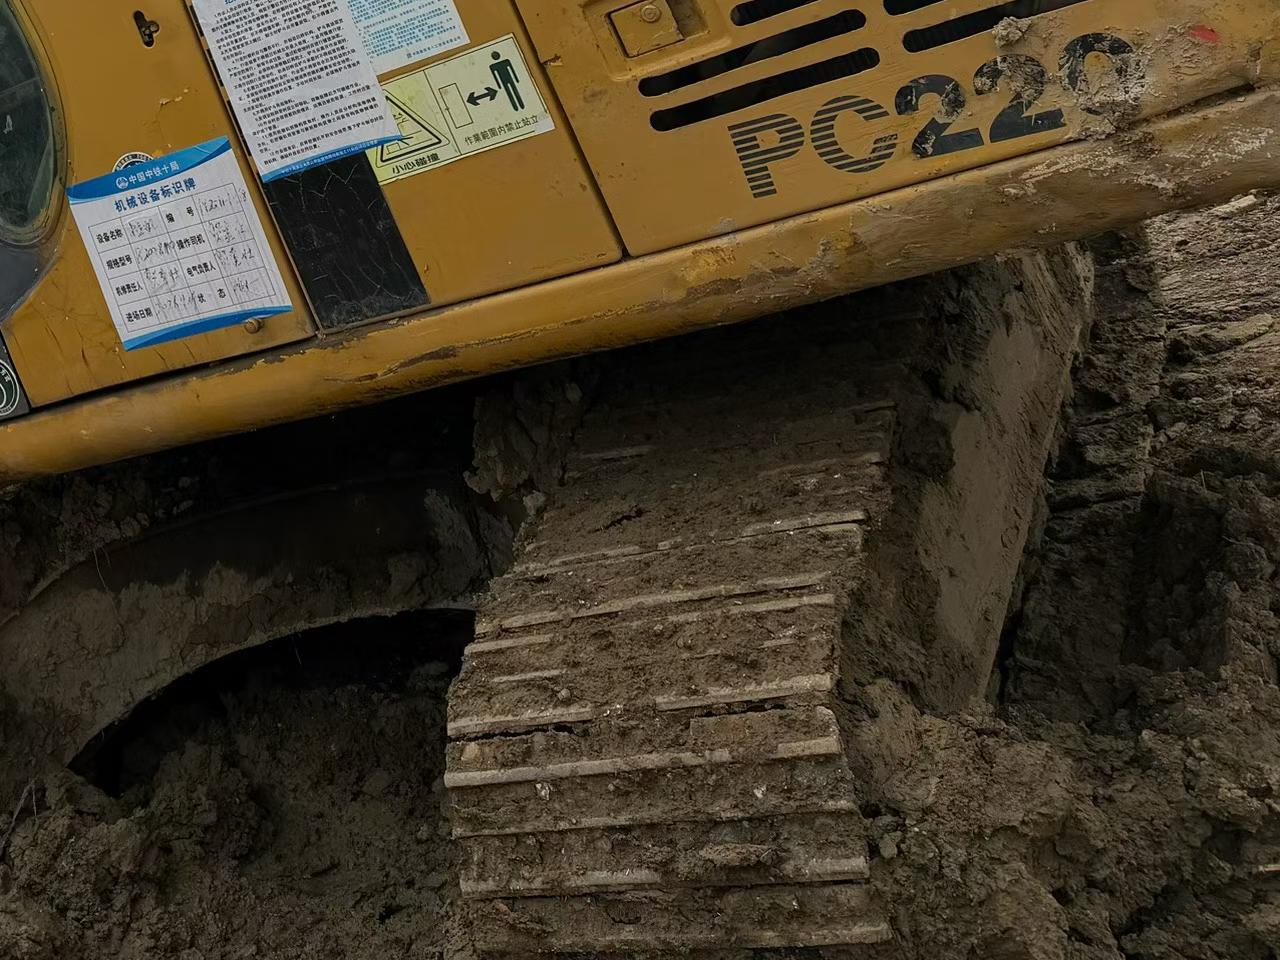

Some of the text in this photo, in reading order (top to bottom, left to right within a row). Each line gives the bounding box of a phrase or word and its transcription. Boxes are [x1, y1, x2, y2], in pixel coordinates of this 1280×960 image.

[127, 159, 180, 185] 中国中铁十局
[391, 151, 440, 175] 小心碰撞
[113, 176, 197, 212] 机械设备标识牌
[95, 227, 123, 244] 设备名称
[176, 233, 205, 250] 操作司机
